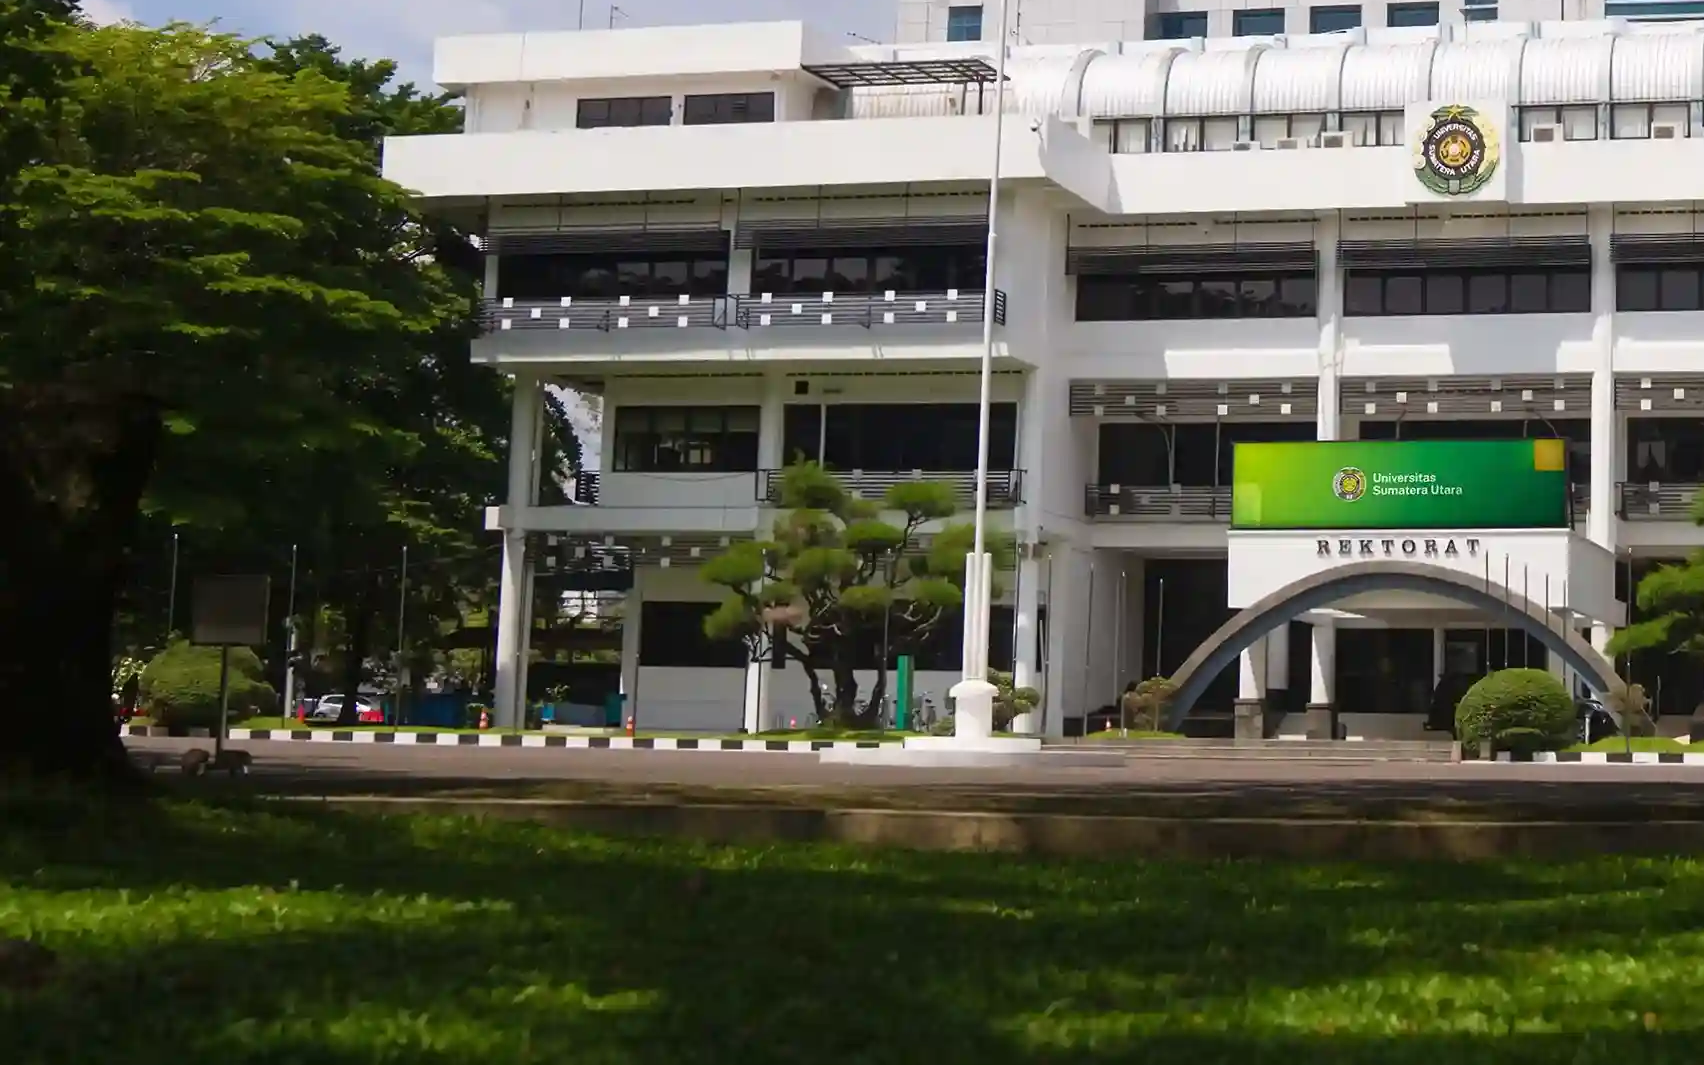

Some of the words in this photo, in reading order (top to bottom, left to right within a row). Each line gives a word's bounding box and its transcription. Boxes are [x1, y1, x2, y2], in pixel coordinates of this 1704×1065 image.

[1433, 123, 1478, 141] UNIVERSITAS
[1460, 149, 1480, 174] UTARA
[1372, 472, 1436, 484] Universitas
[1372, 485, 1428, 496] Sumatera
[1431, 484, 1463, 495] Utara
[1316, 538, 1481, 557] REKTORAT
